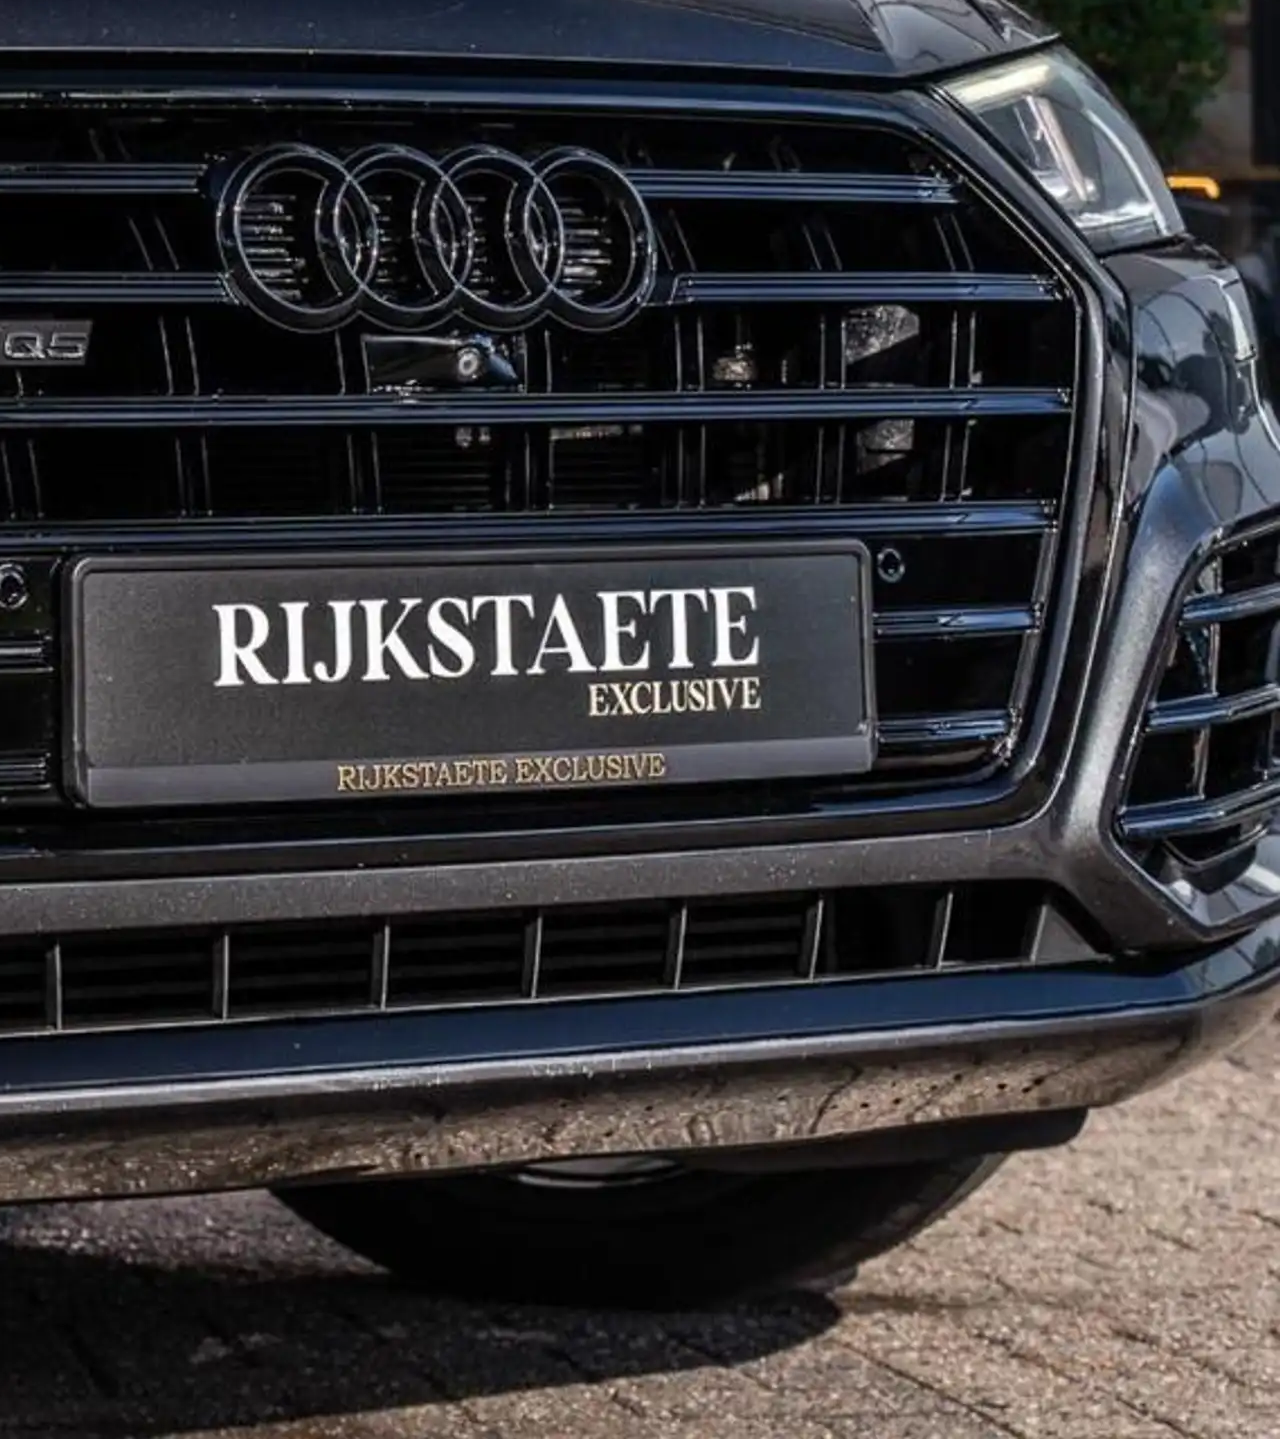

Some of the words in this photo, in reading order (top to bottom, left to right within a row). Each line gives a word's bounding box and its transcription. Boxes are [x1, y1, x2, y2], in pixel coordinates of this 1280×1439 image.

[211, 586, 760, 687] RIJKSTAETE
[588, 677, 761, 717] EXCLUSIVE
[336, 759, 510, 791] RIJKSTAETE
[514, 753, 667, 786] EXCLUSIVE
